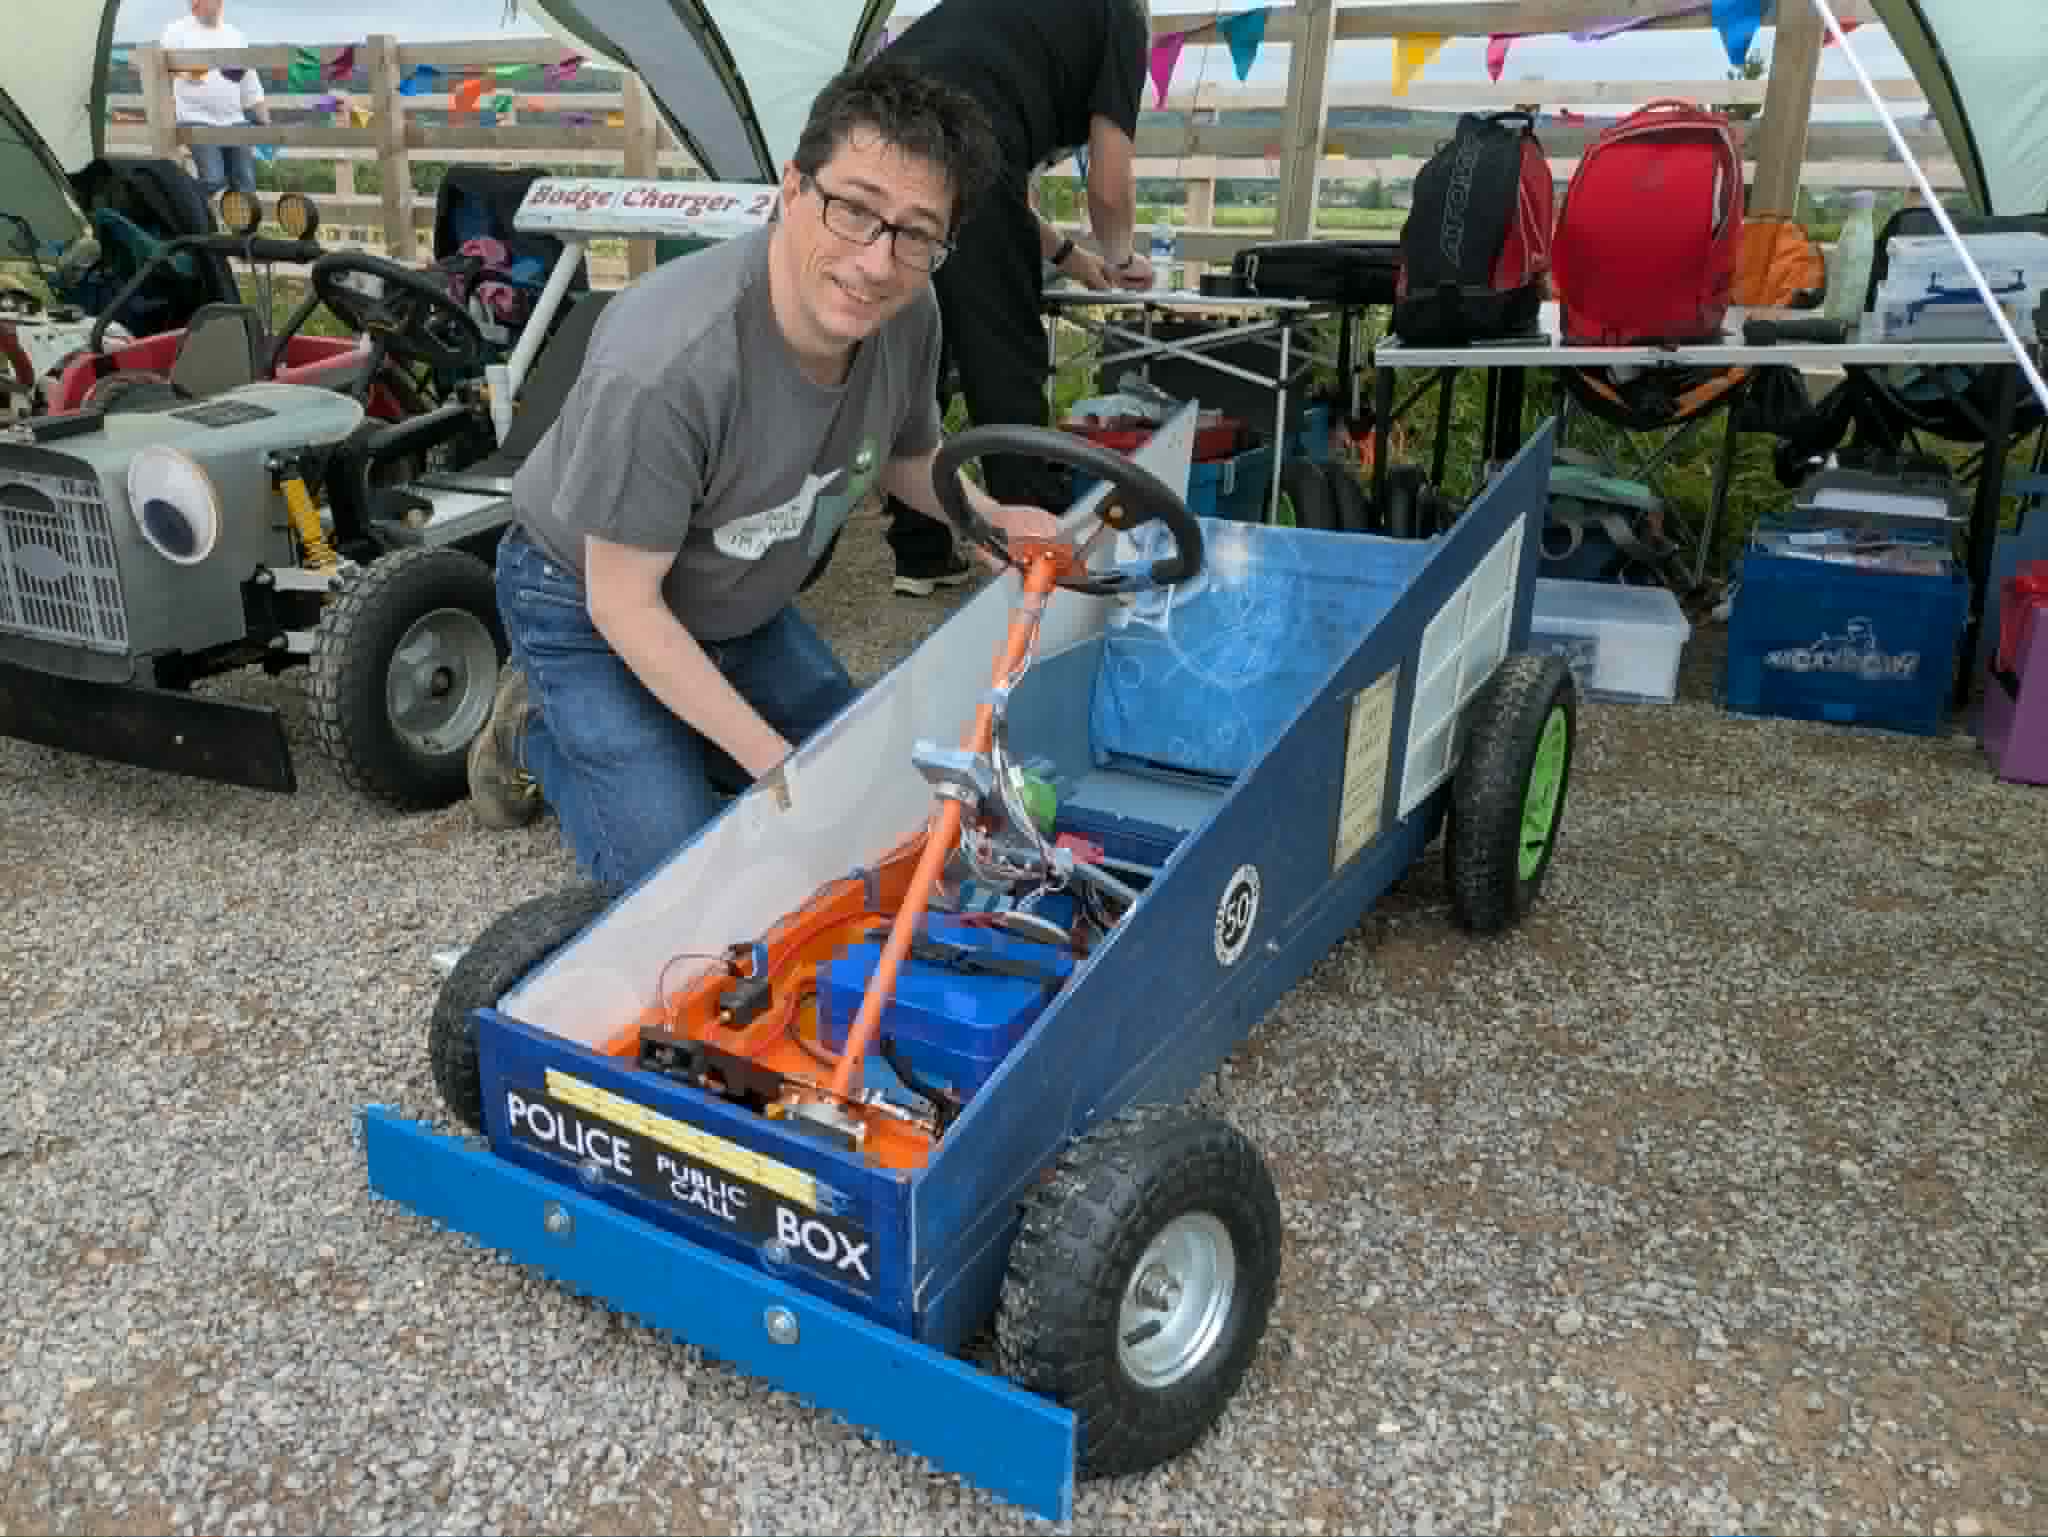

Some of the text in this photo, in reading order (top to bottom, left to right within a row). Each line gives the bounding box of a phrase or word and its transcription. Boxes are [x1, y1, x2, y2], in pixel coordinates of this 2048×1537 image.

[530, 184, 771, 217] Bodge Charger 2
[507, 1090, 633, 1177] POLICE
[656, 1153, 748, 1208] PUBLIC
[670, 1180, 737, 1221] CALL
[775, 1207, 872, 1280] BOX
